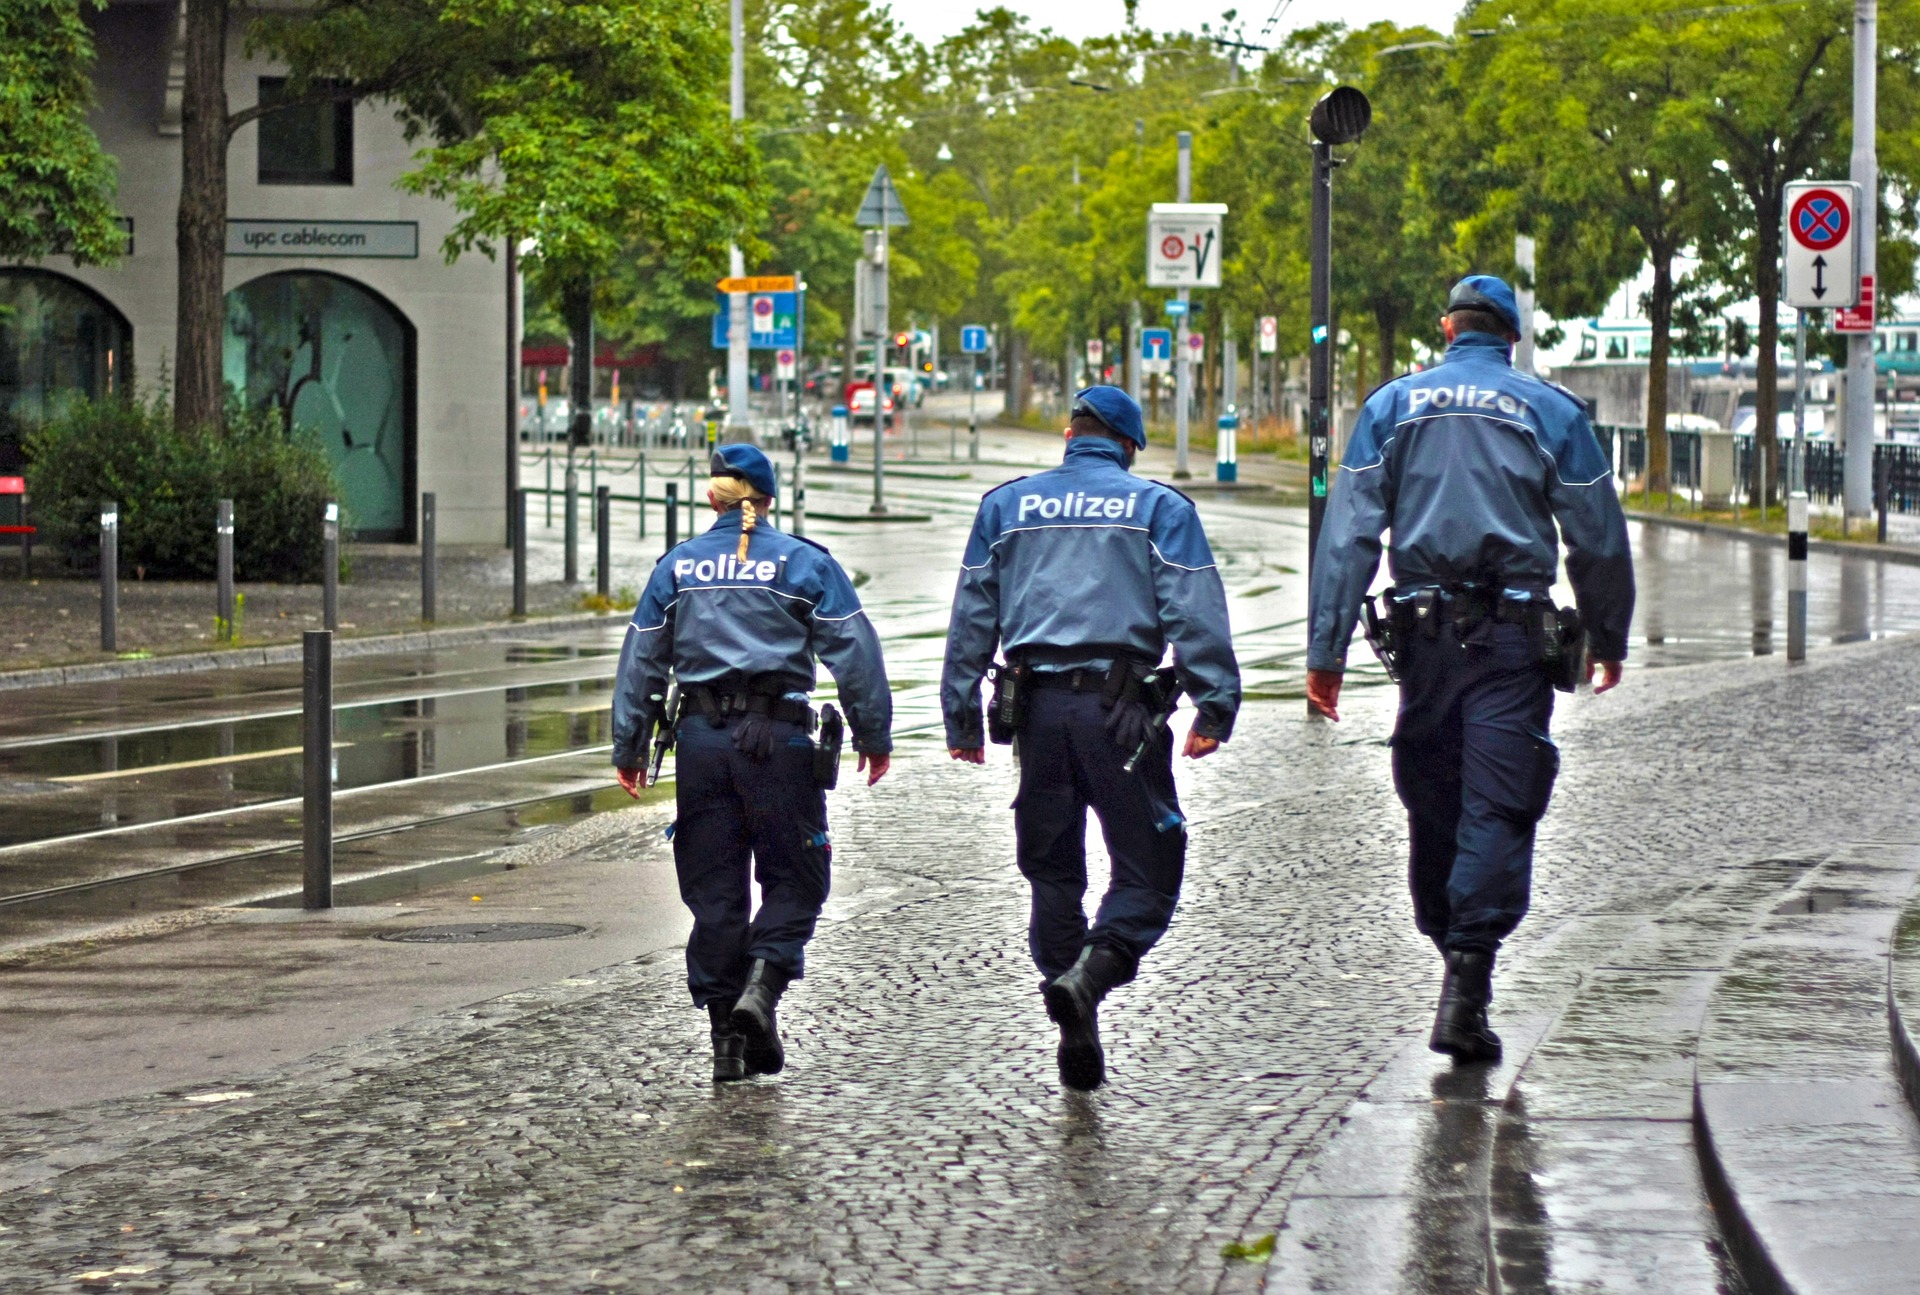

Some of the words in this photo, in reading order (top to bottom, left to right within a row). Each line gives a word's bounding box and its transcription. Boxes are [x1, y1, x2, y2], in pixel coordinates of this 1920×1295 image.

[243, 231, 276, 249] upc
[281, 227, 366, 246] cablecom
[1409, 384, 1530, 419] Polizei
[1018, 492, 1137, 521] Polizei
[674, 554, 787, 583] Polizei
